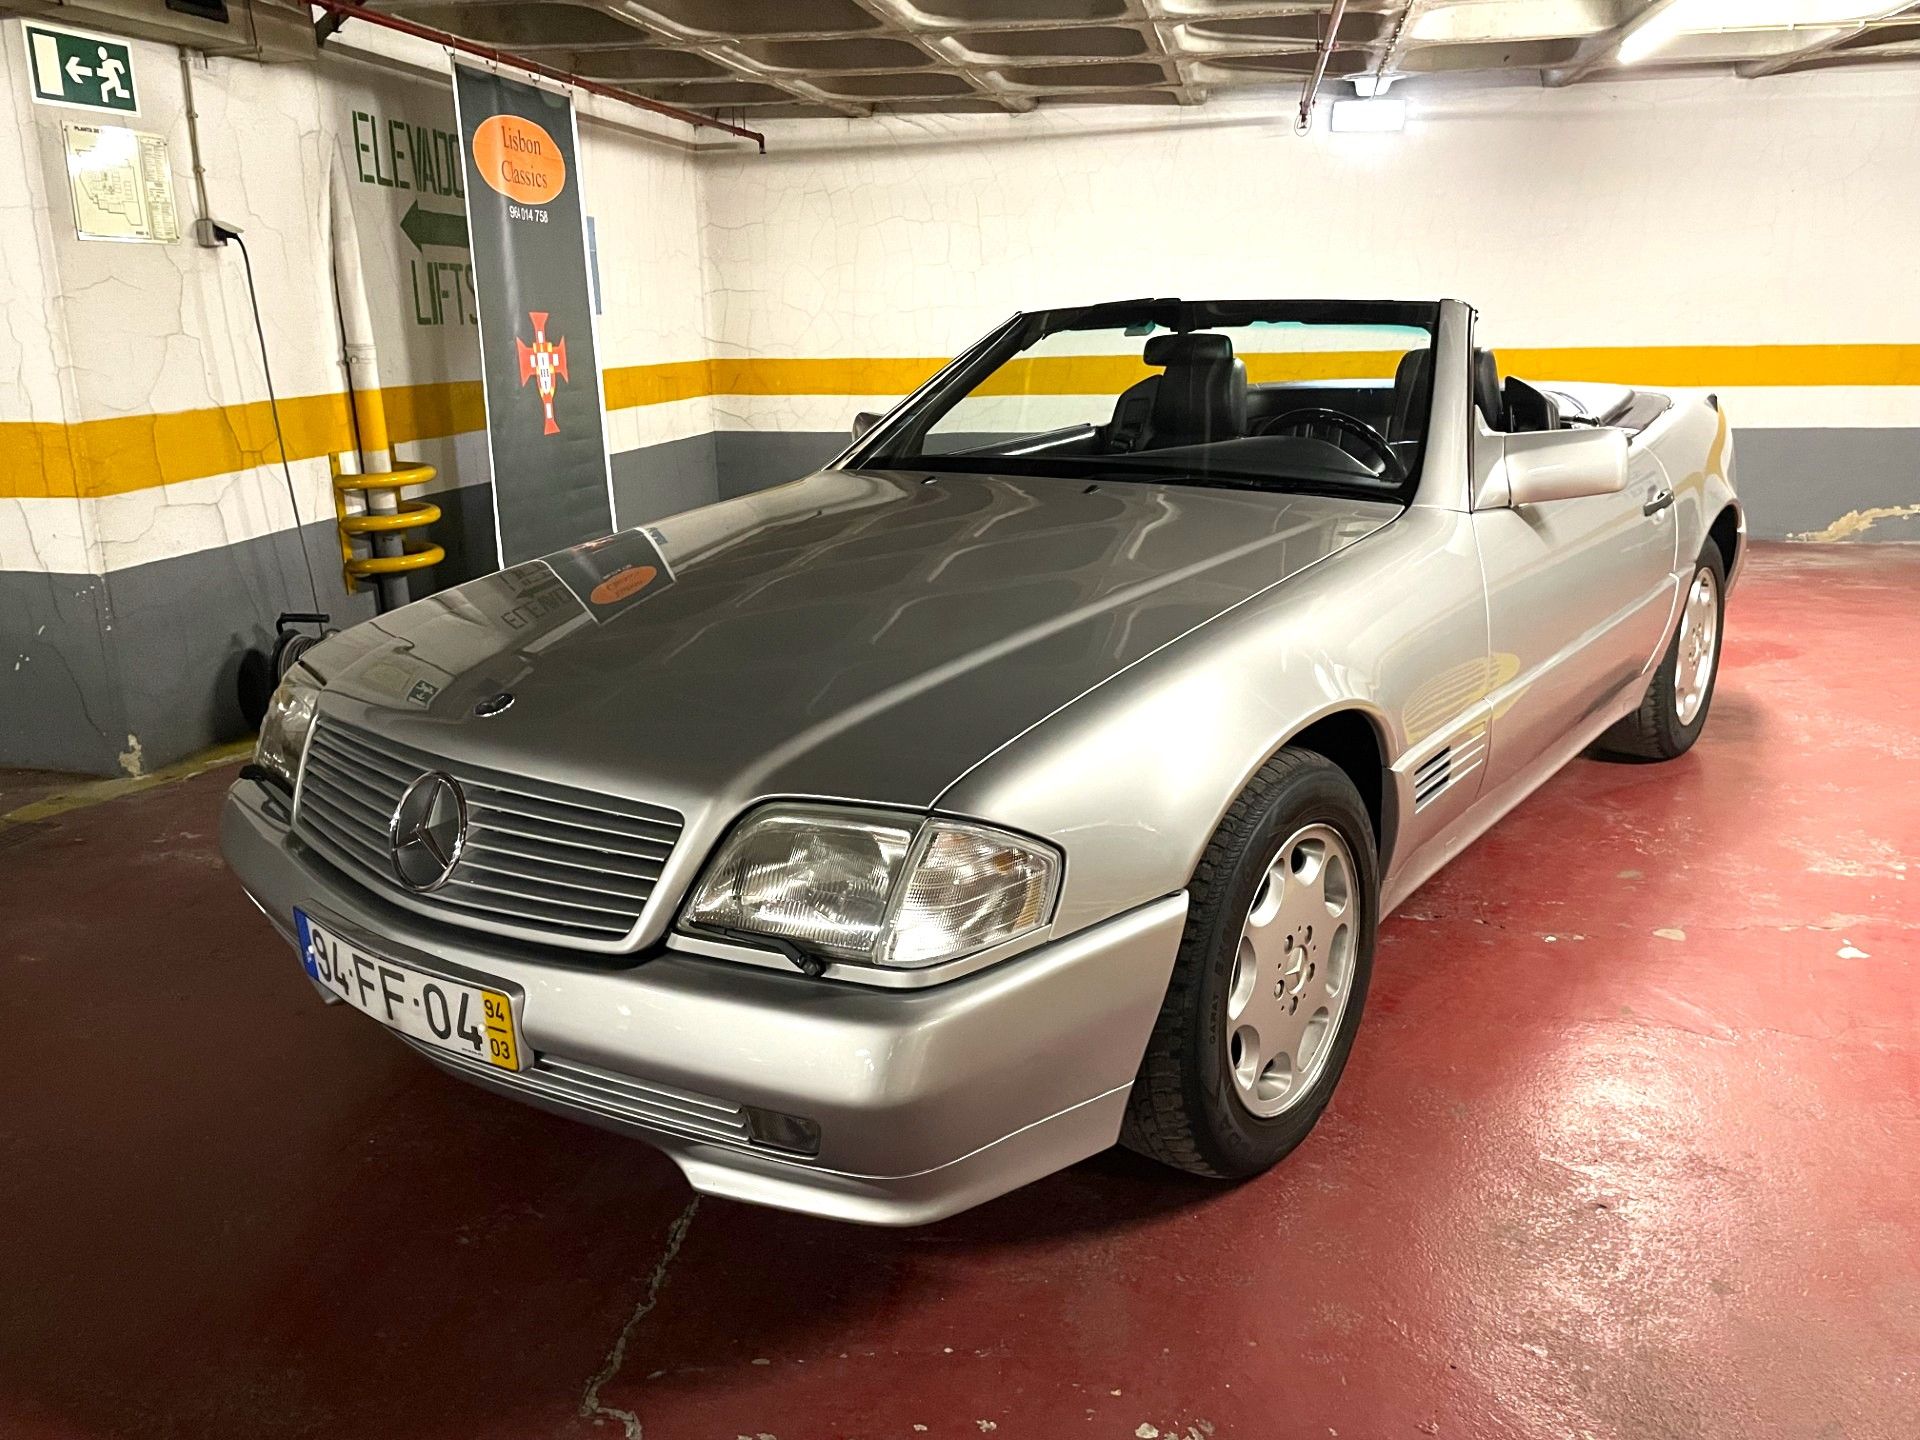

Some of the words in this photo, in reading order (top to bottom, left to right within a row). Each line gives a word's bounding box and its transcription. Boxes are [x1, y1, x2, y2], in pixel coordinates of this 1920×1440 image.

[501, 125, 542, 155] Lisbon
[501, 160, 548, 189] Classics
[534, 209, 549, 223] 758
[484, 999, 505, 1021] 94
[490, 1037, 511, 1060] 03
